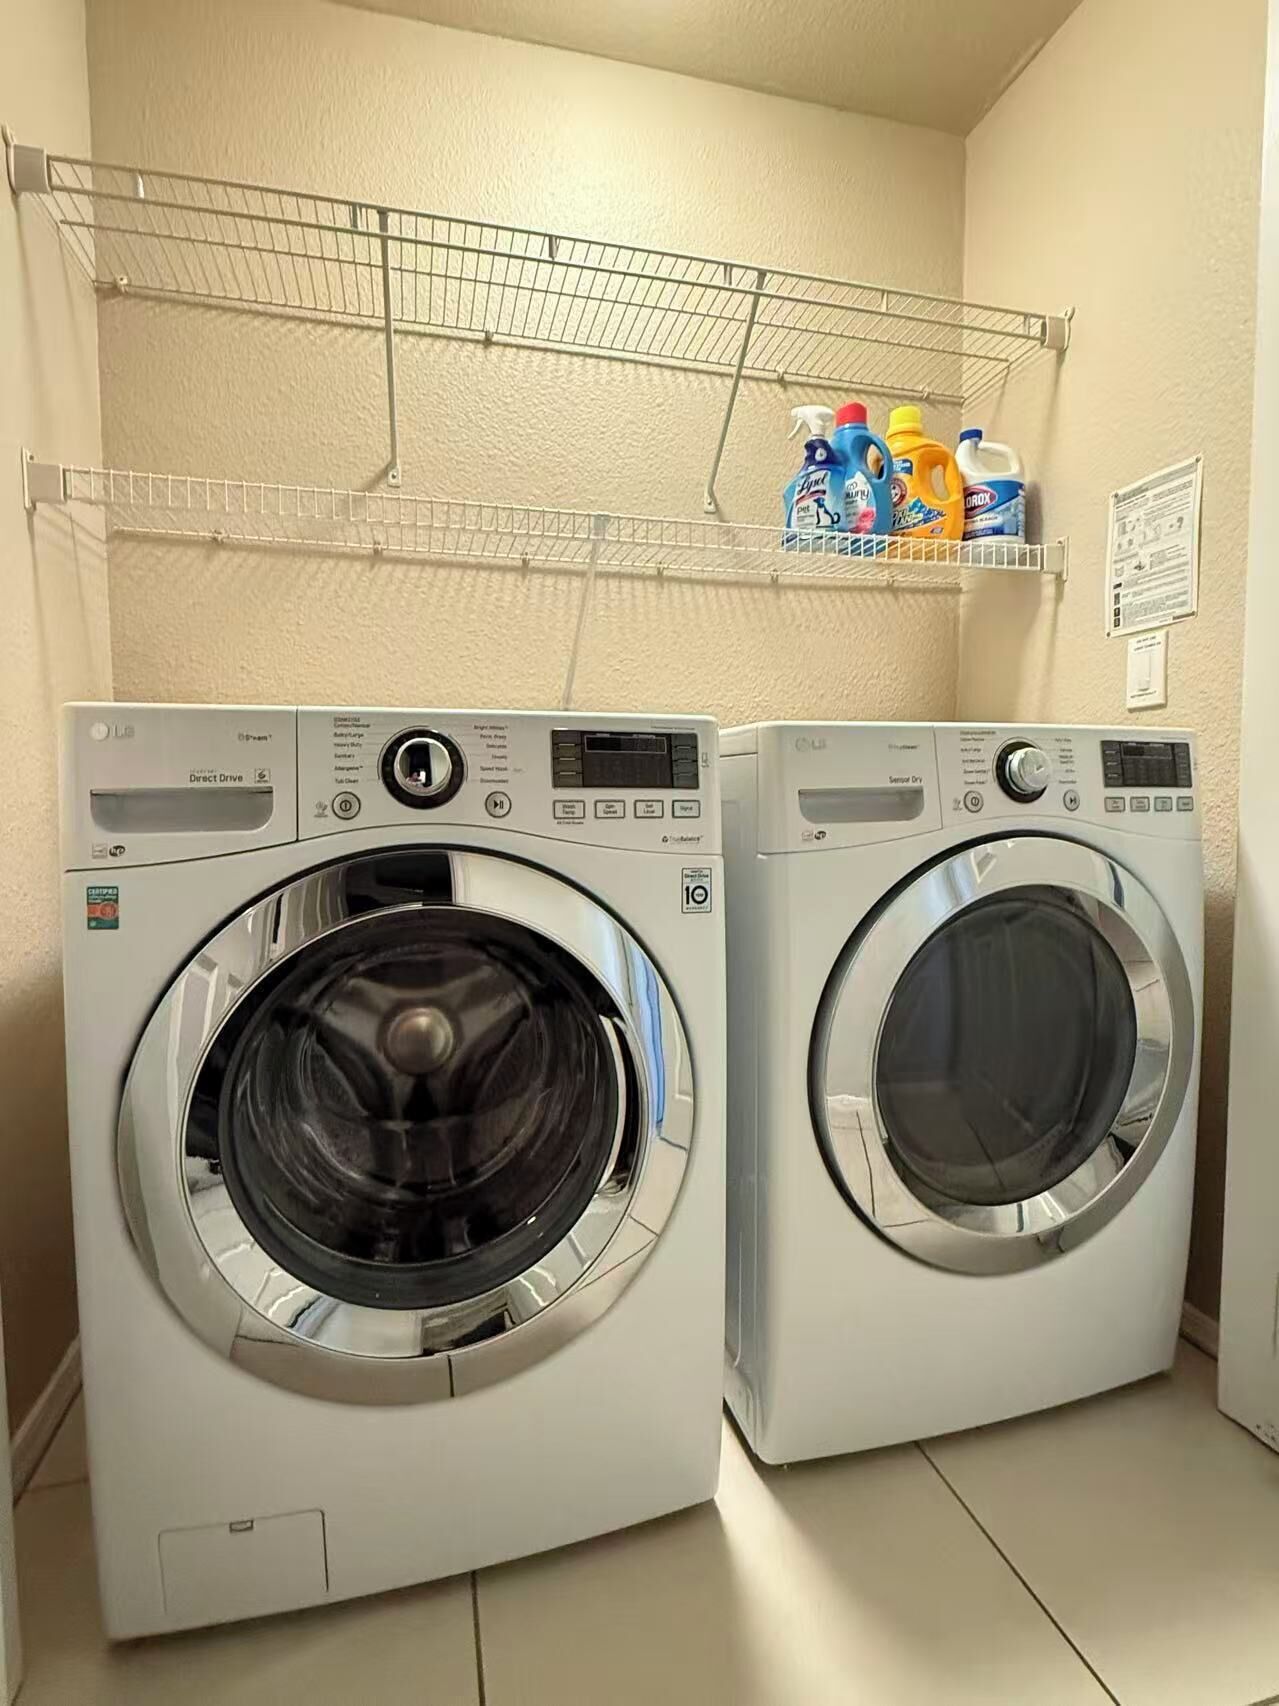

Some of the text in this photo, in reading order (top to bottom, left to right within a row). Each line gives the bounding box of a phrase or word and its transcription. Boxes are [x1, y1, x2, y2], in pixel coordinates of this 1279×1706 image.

[799, 472, 826, 495] Lysol
[966, 493, 991, 508] OROX
[796, 503, 810, 515] pet
[189, 773, 243, 783] Direct Drive
[888, 775, 923, 784] Sensor Dry
[685, 885, 708, 905] 10
